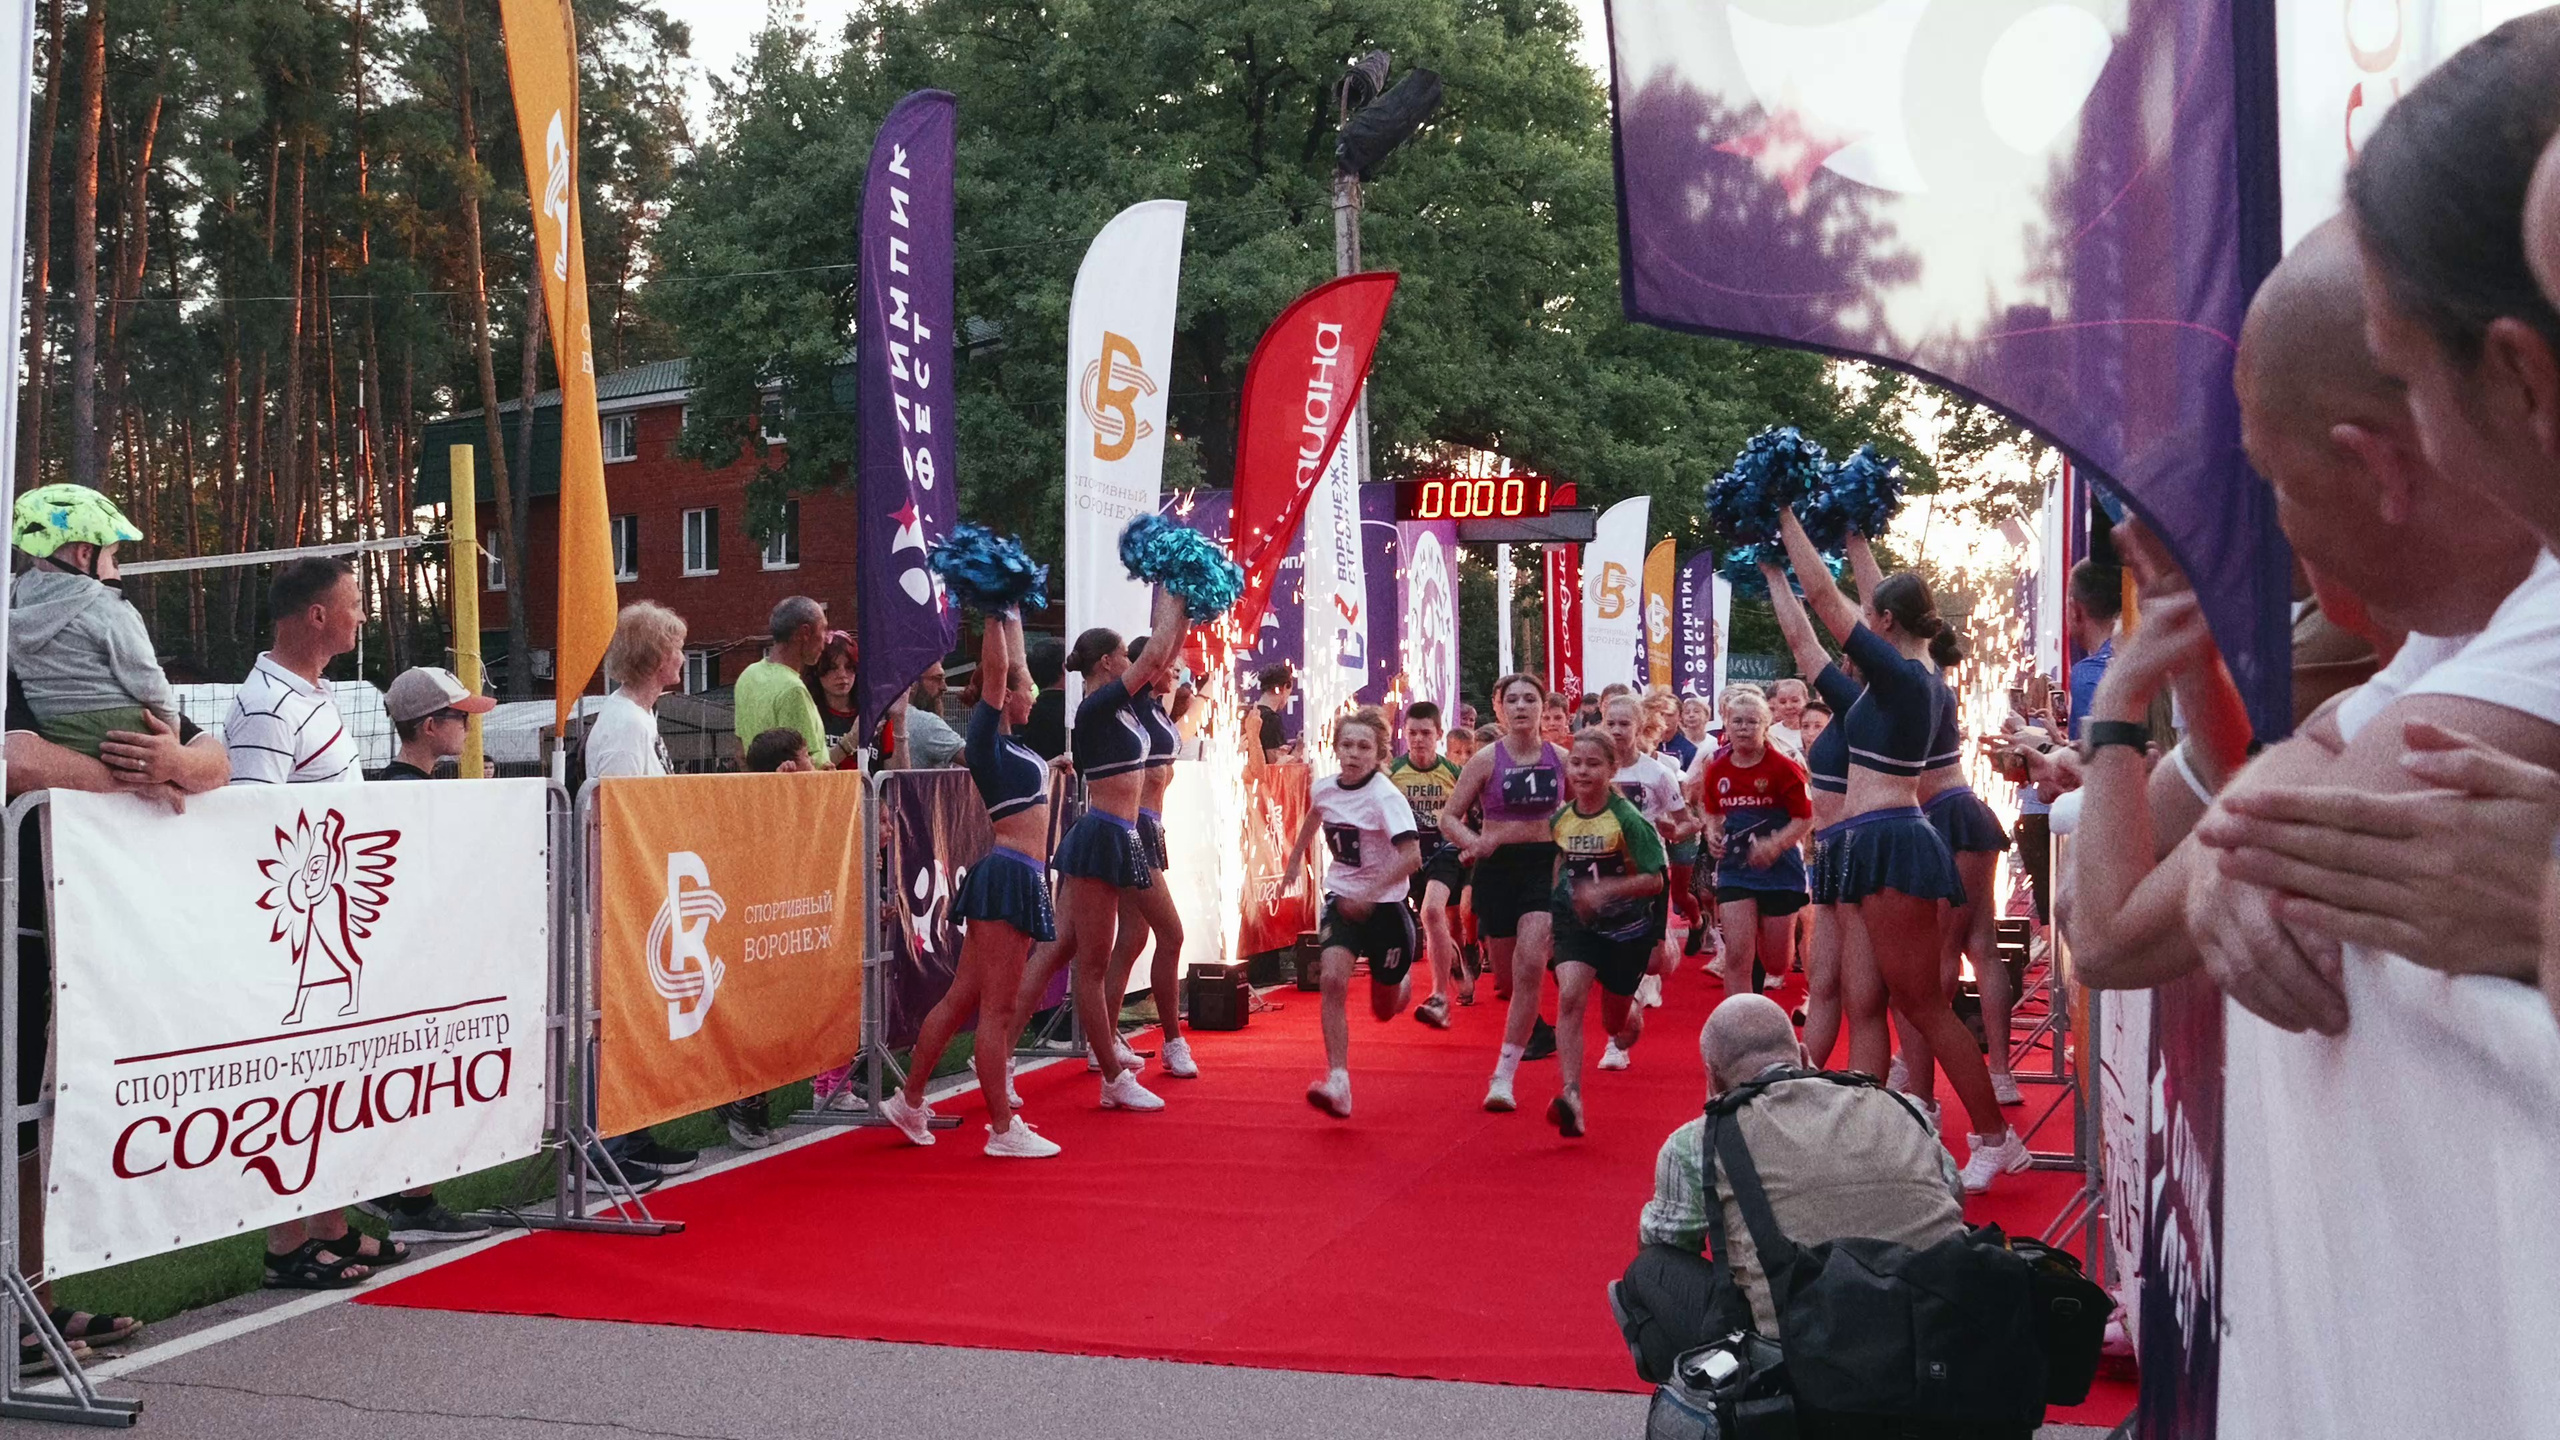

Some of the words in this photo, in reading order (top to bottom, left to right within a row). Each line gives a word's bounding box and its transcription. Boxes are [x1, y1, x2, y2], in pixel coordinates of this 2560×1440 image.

[888, 143, 914, 482] ОЛИМПИК
[914, 312, 935, 491] ФЕСТ
[1075, 474, 1148, 504] ПОТИВНЫЙ
[1681, 568, 1695, 673] ОЛИМПИК
[1695, 617, 1708, 673] ФЕСТ
[1406, 783, 1443, 797] ТРЕЙЛ
[1524, 772, 1537, 795] 1
[1408, 799, 1447, 813] АЛДА
[1719, 796, 1773, 808] RUSSIA
[1332, 831, 1343, 854] 1
[1587, 861, 1600, 885] 1
[743, 889, 833, 924] СПОРТИВНЫЙ
[743, 925, 833, 963] ВОРОНЕЖ
[114, 1016, 439, 1108] спортивно-культурный
[441, 1012, 511, 1056] центр
